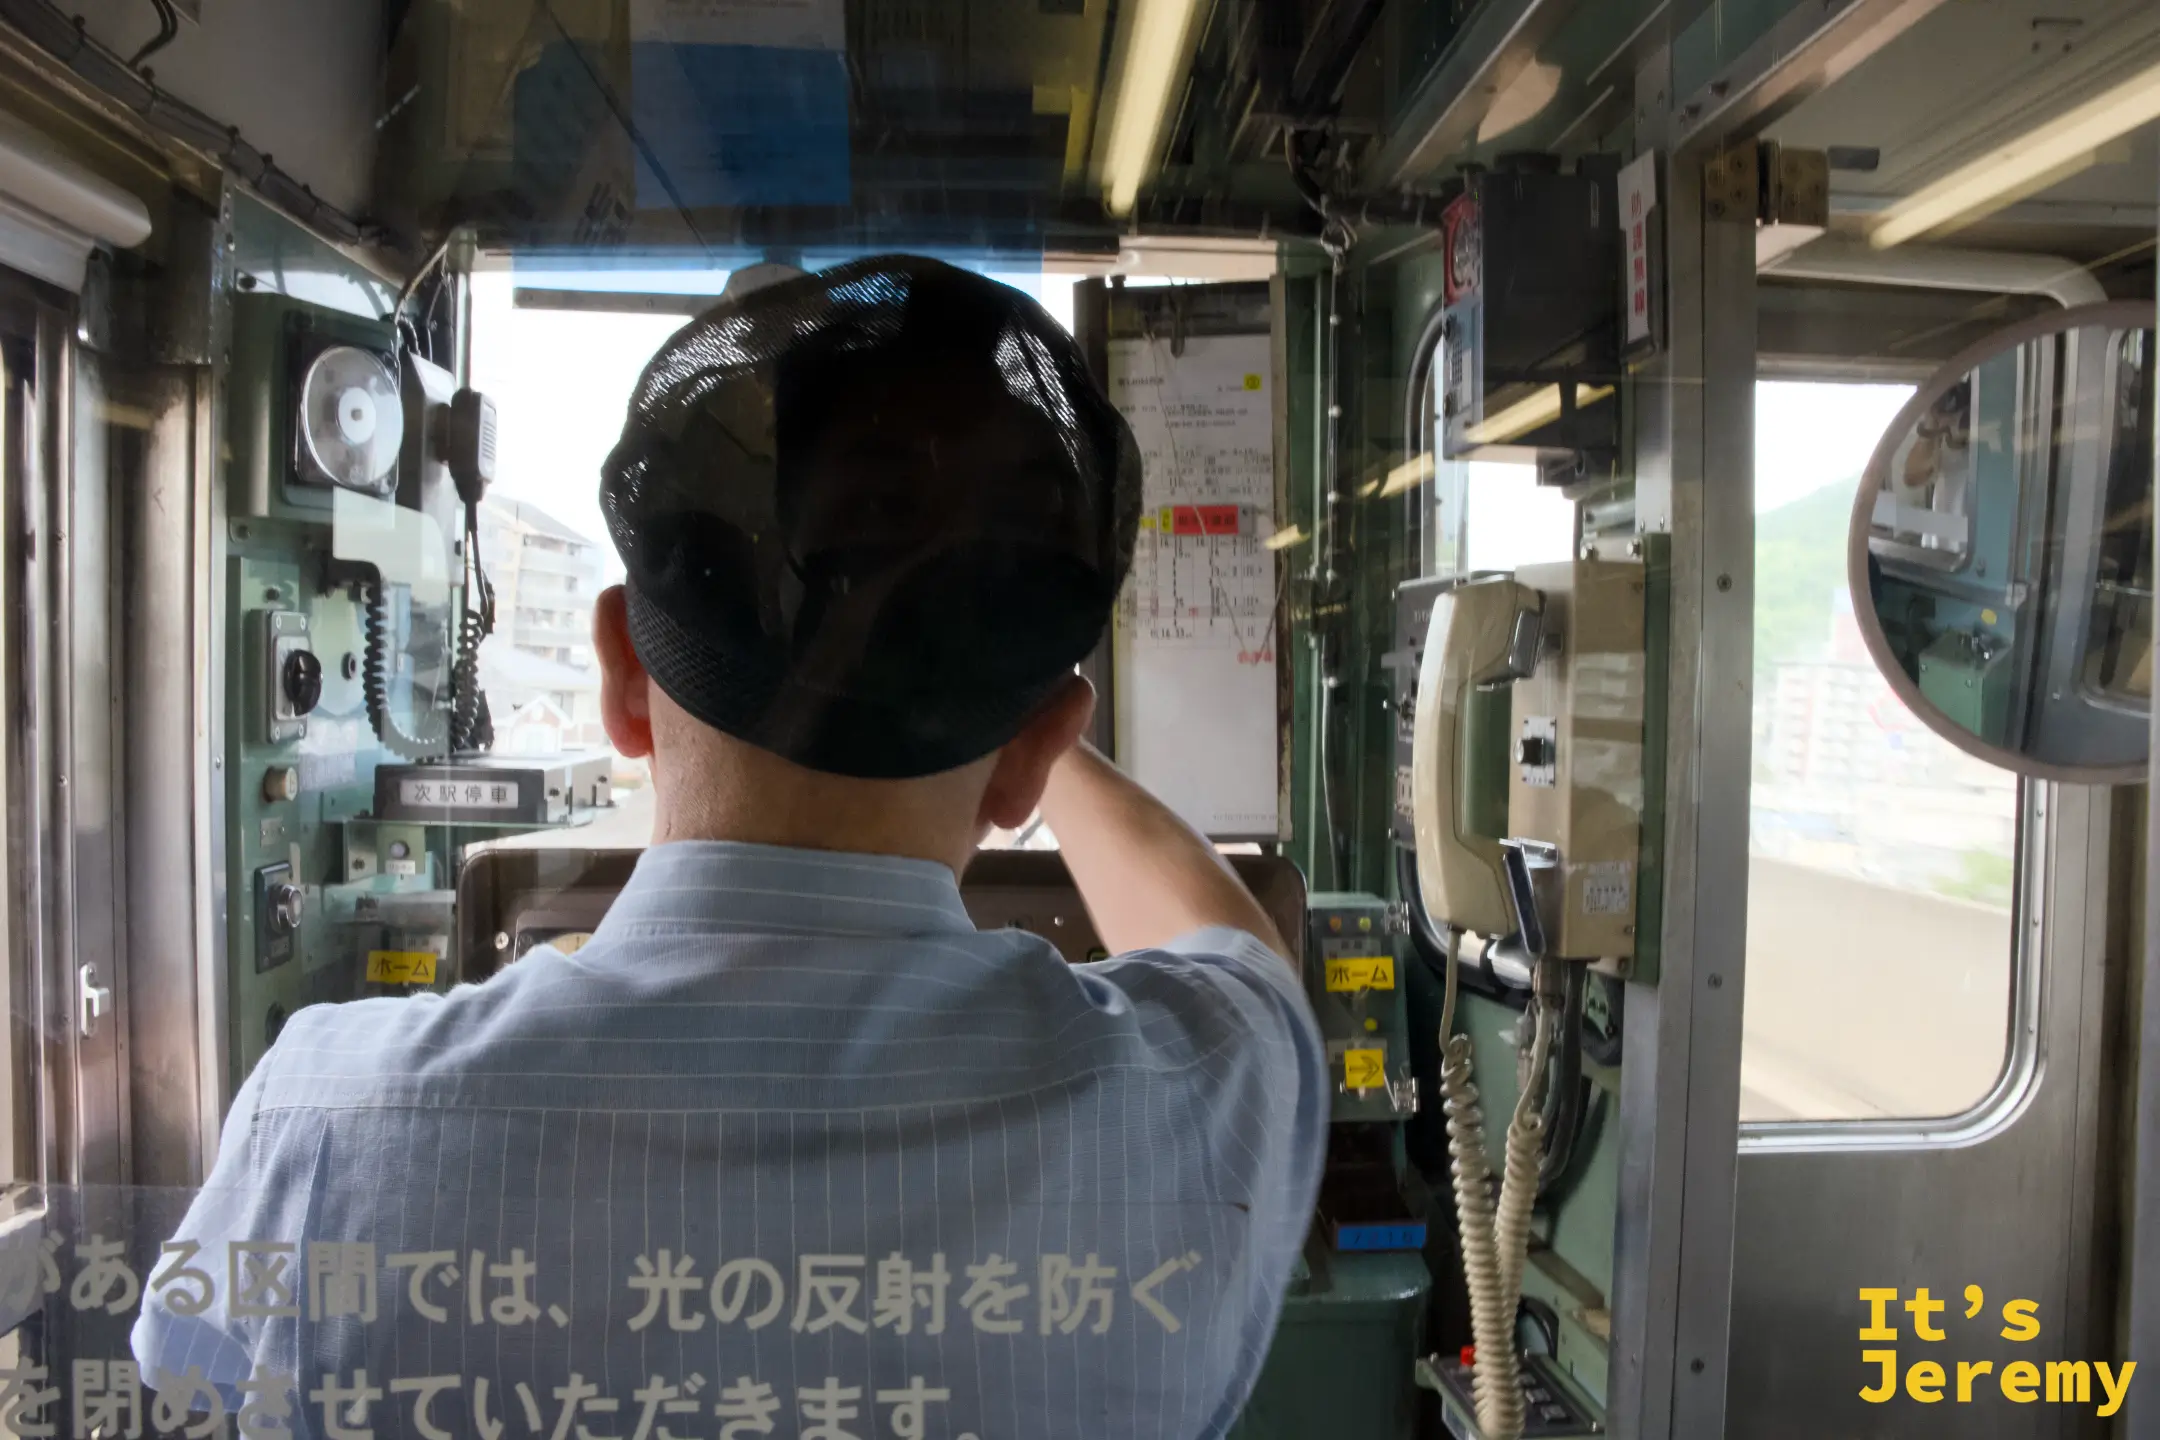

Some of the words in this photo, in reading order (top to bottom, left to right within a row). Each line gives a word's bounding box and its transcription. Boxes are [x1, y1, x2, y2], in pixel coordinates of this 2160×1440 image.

[414, 784, 507, 804] 次駅停車
[373, 957, 429, 976] ホーム
[1331, 964, 1388, 985] ホーム
